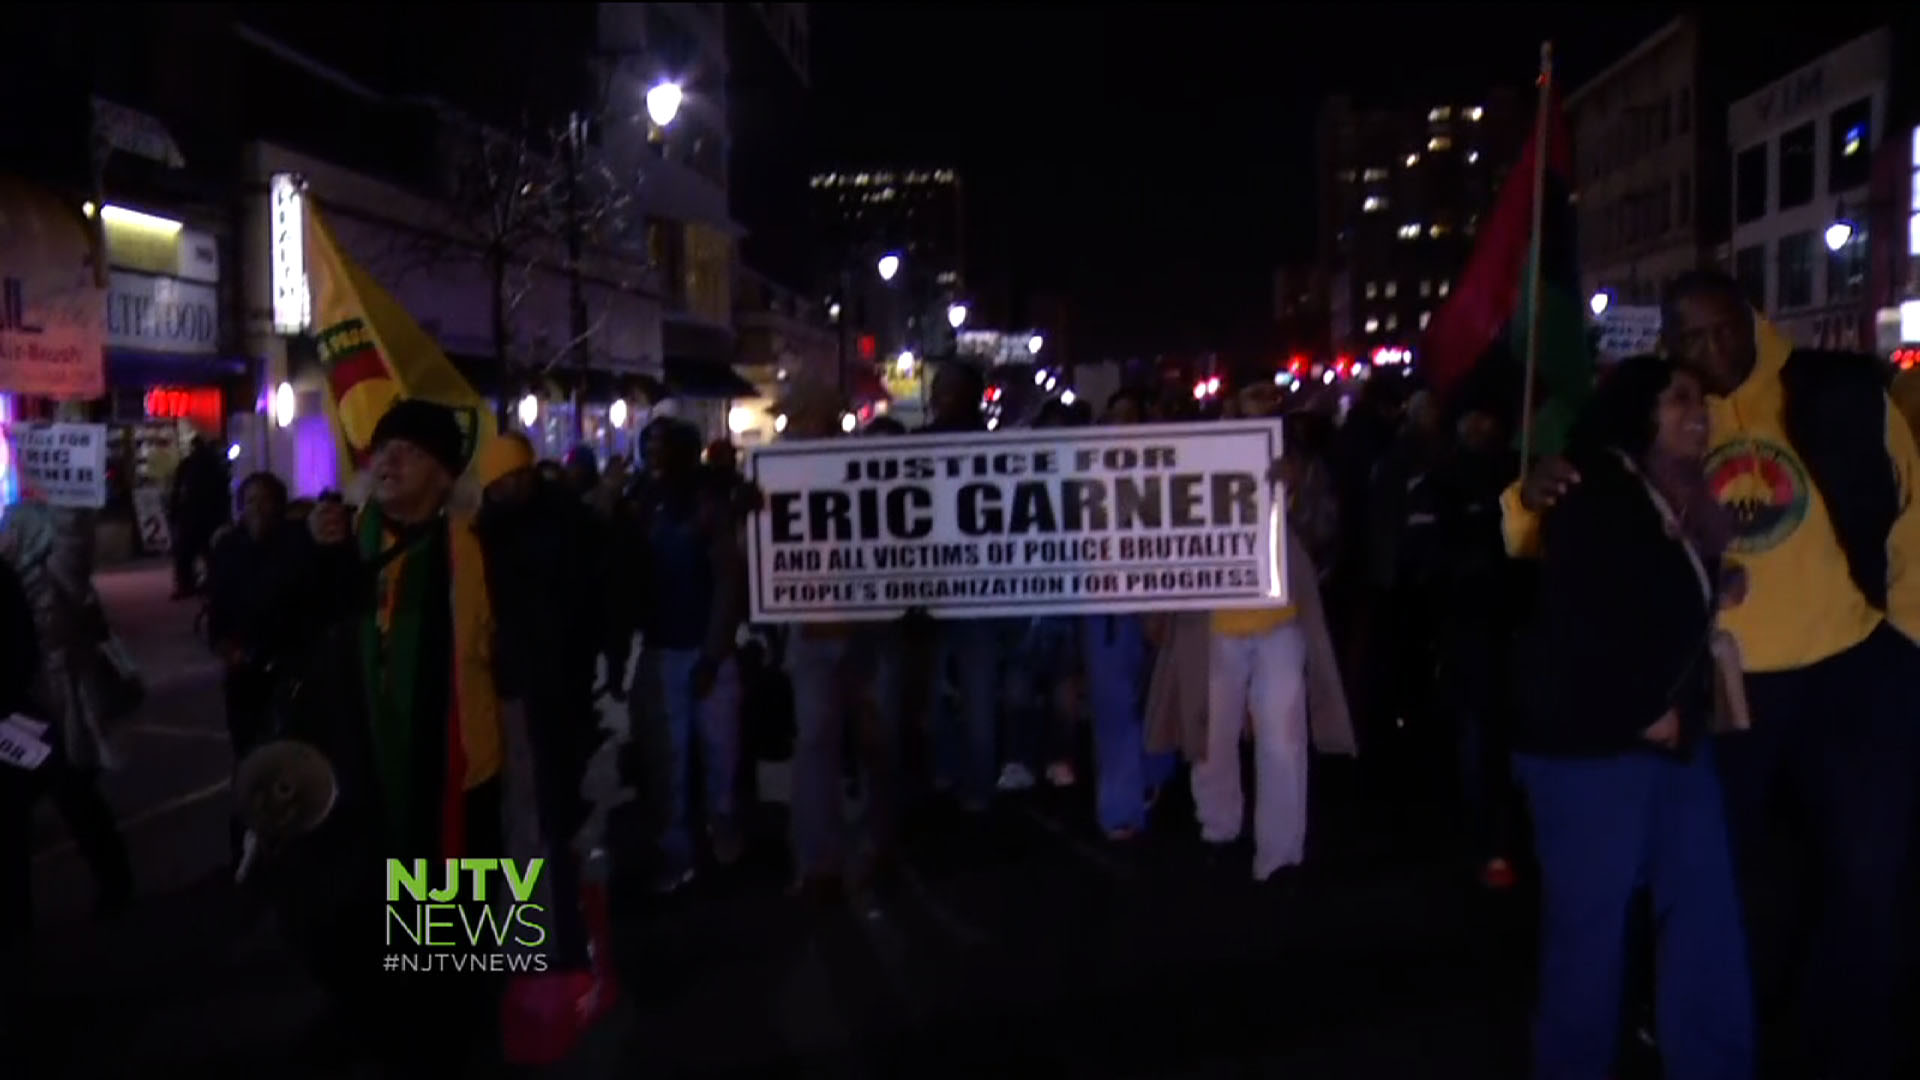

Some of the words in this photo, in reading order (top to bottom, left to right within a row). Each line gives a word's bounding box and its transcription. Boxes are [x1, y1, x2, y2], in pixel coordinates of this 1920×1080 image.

[845, 452, 1058, 483] JUSTICE
[1074, 447, 1176, 472] FOR
[770, 486, 933, 543] ERIC
[957, 472, 1256, 537] GARNER
[773, 548, 821, 573] AND
[829, 546, 865, 571] ALL
[874, 542, 979, 569] VICTIMS
[988, 540, 1015, 564] OF
[1024, 537, 1110, 563] POLICE
[1119, 532, 1257, 560] BRUTALITY
[774, 580, 878, 603] PEOPLE'S
[885, 575, 1063, 600] ORGANIZATION
[1072, 573, 1119, 593] FOR
[1126, 569, 1258, 591] PROGRESS
